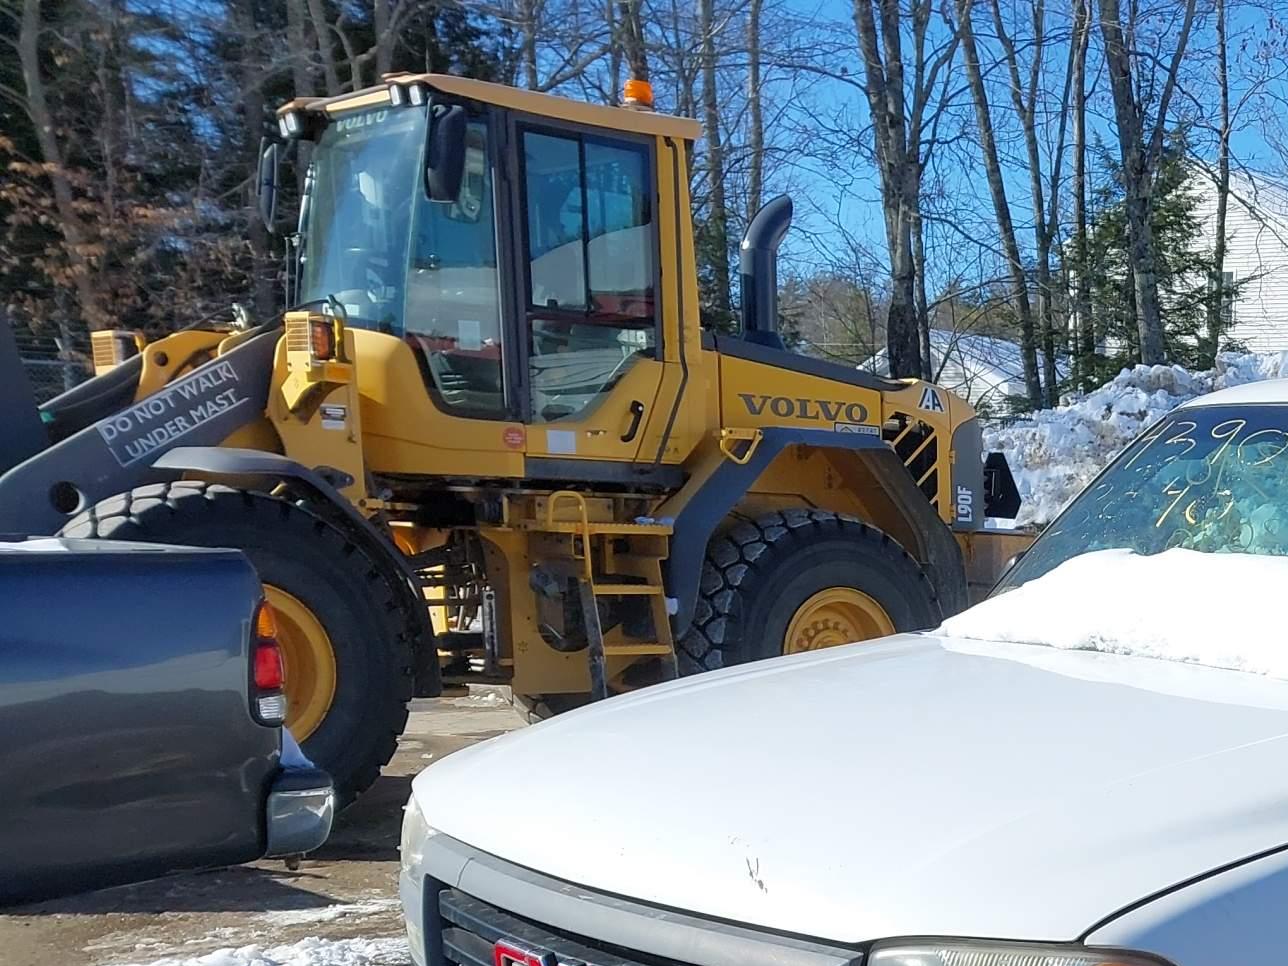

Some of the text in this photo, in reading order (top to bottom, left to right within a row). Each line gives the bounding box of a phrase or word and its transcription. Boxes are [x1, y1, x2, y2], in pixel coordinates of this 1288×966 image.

[101, 364, 234, 440] DO NOT WALK
[124, 388, 237, 457] UNDER MAST
[738, 393, 868, 423] VOLVO
[956, 485, 973, 523] L90F
